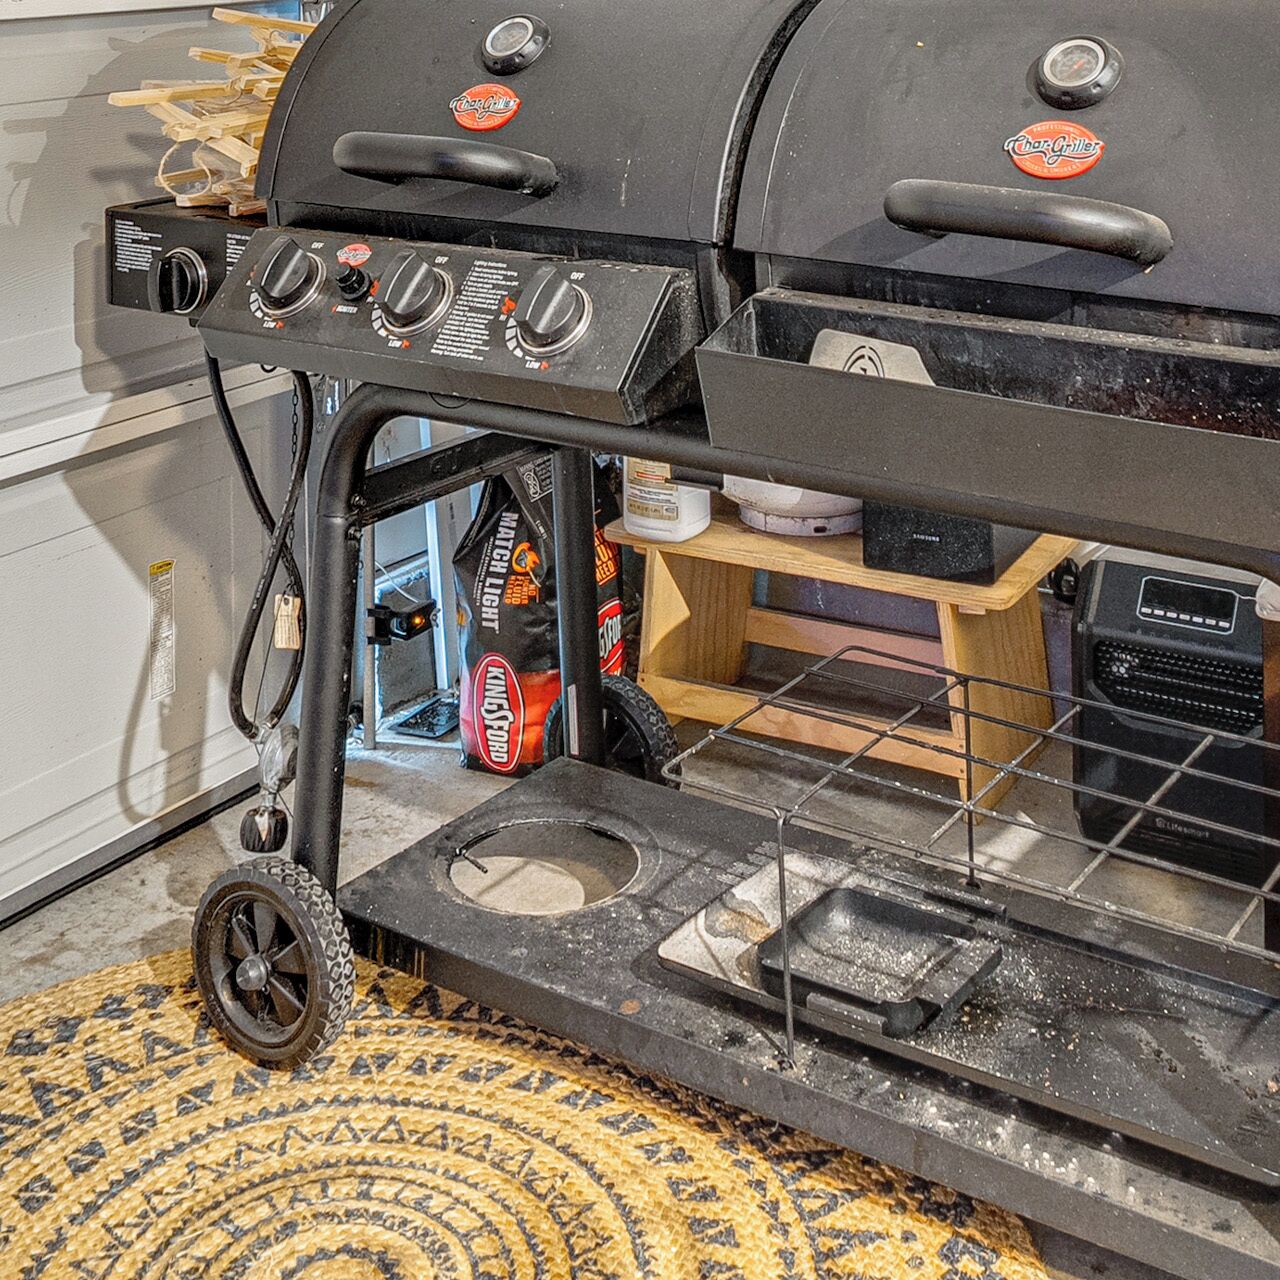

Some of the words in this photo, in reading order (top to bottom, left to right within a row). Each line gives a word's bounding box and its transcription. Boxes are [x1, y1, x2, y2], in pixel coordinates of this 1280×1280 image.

[1004, 134, 1104, 167] Char-Griller
[435, 256, 448, 264] OFF
[571, 272, 585, 280] OFF
[388, 340, 402, 348] LOW
[525, 361, 540, 369] LOW
[489, 512, 519, 573] MATCH
[913, 533, 940, 543] SAMSUNG
[512, 576, 524, 605] FLUID
[529, 584, 536, 596] NO
[482, 577, 505, 629] LIGHT
[481, 666, 515, 763] KINGSFORD
[1167, 820, 1210, 839] Lifesmart
